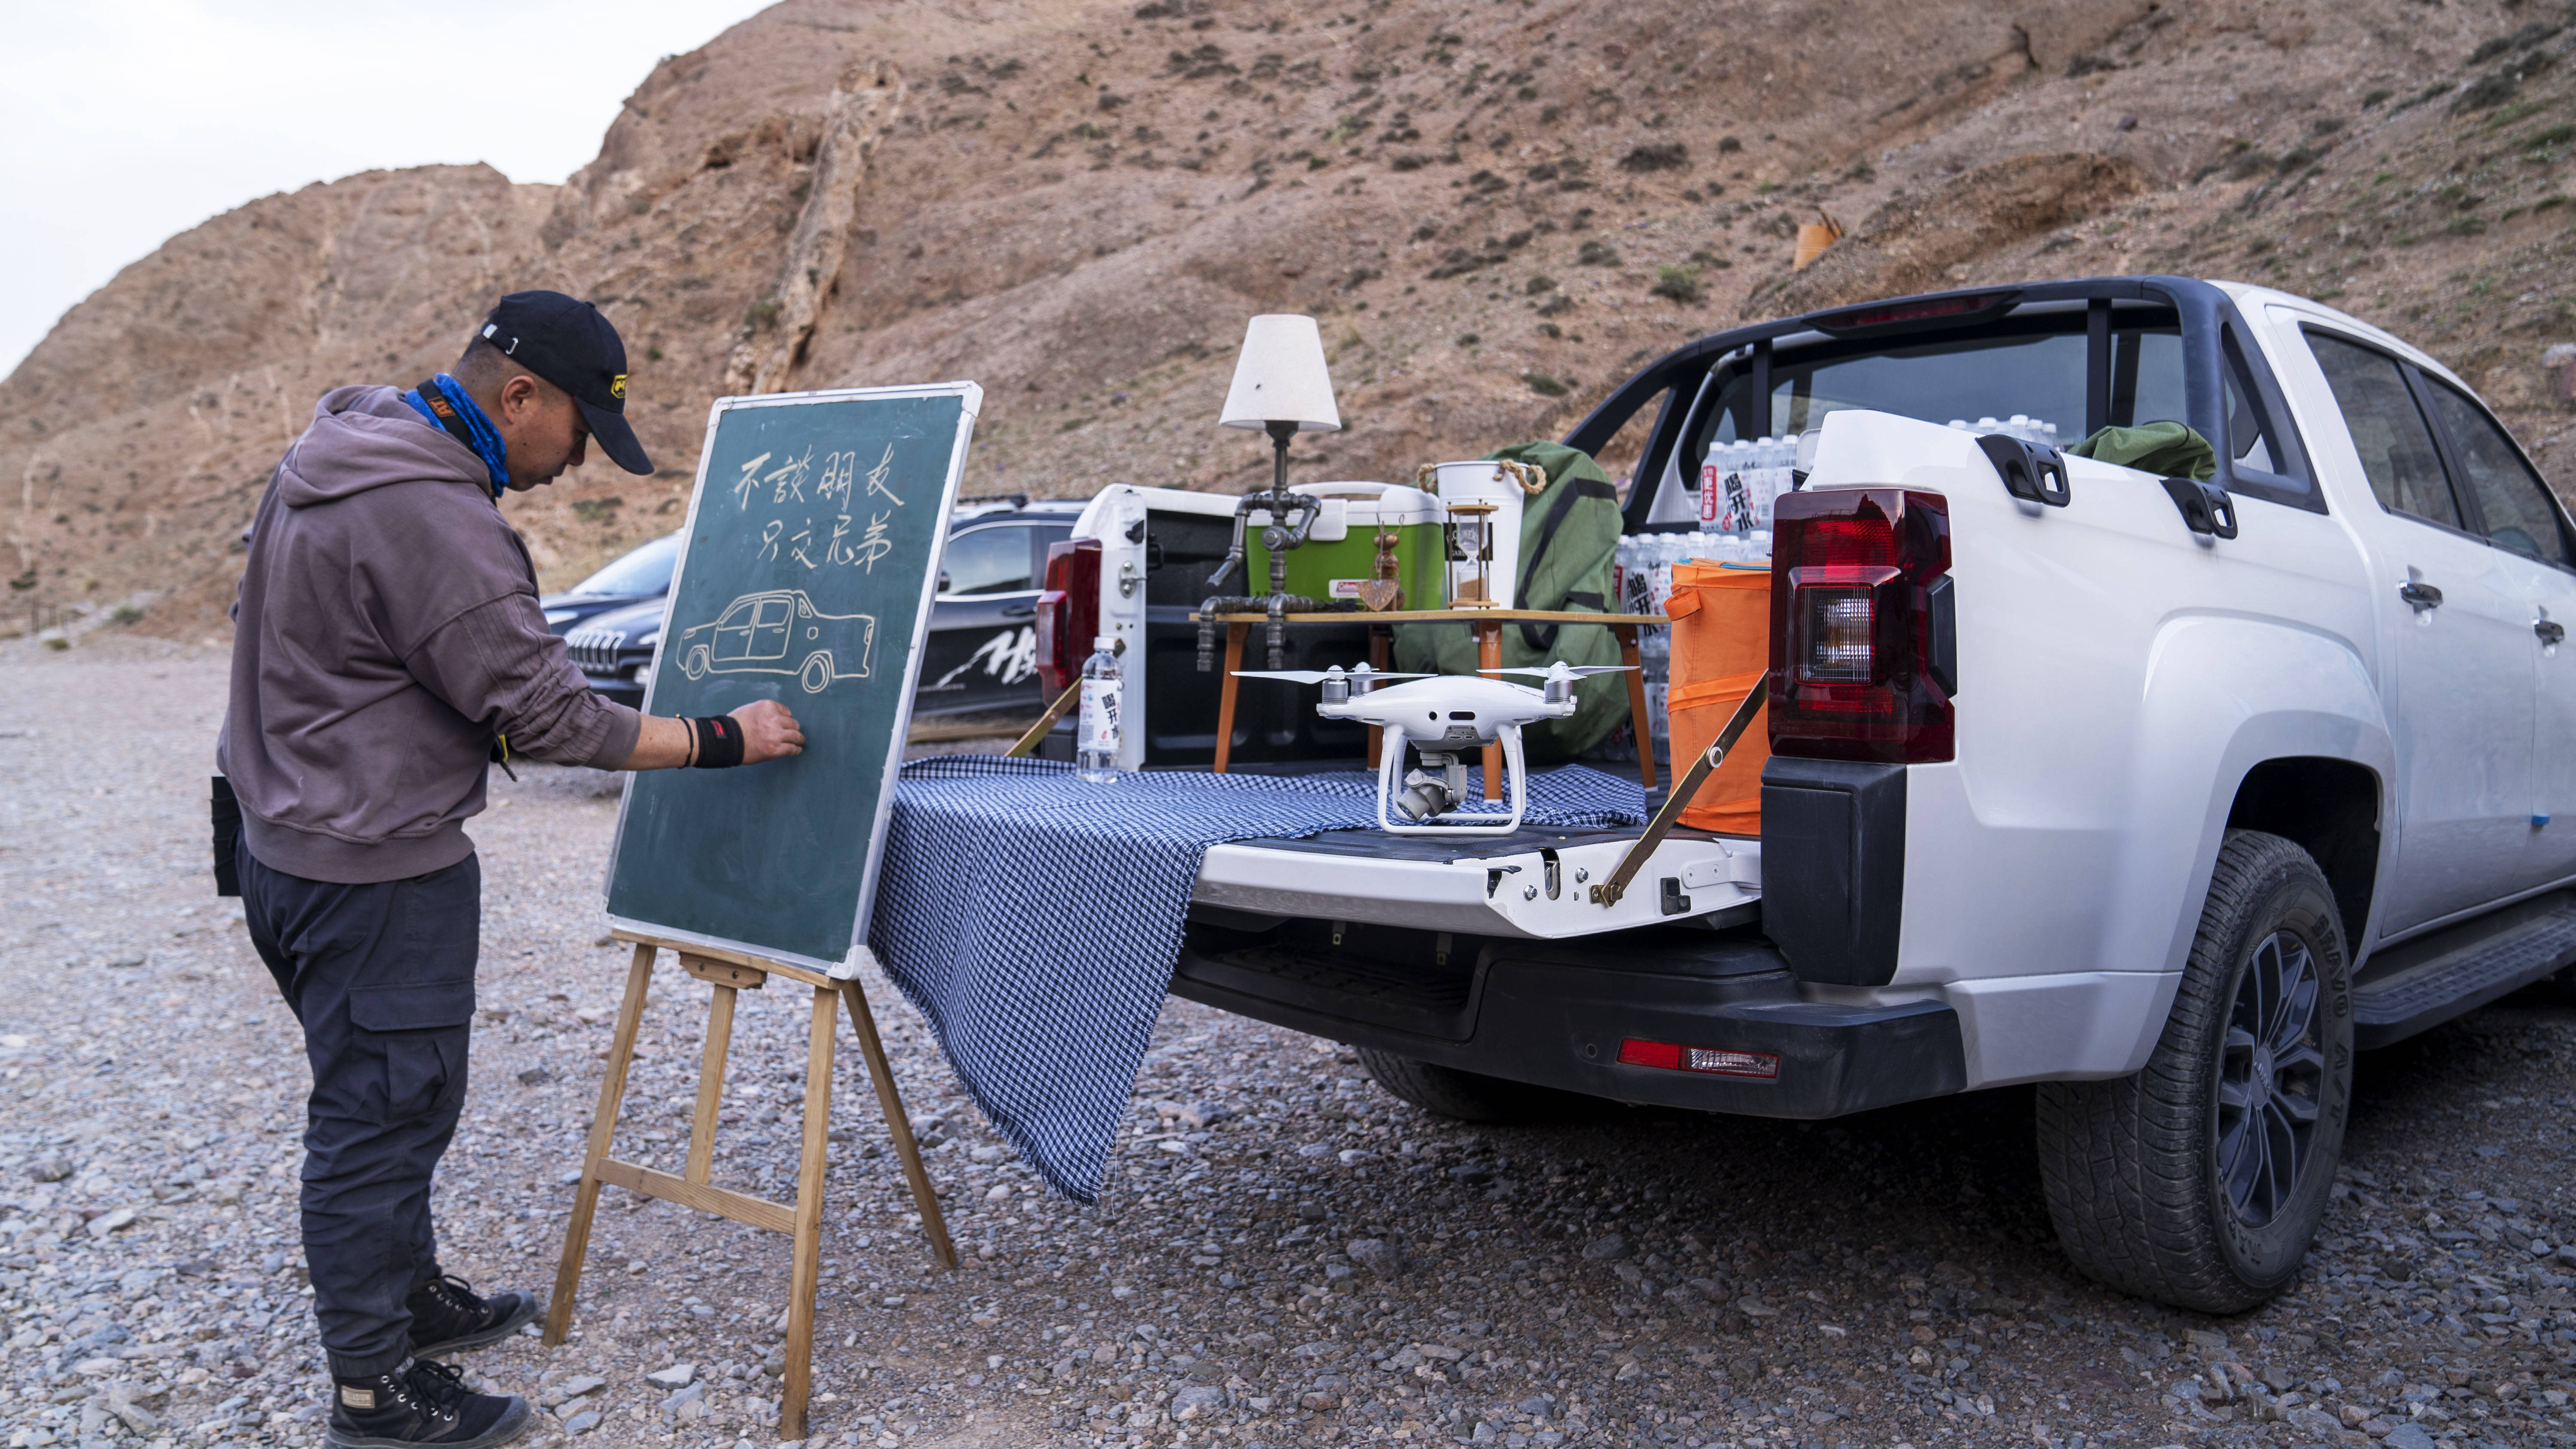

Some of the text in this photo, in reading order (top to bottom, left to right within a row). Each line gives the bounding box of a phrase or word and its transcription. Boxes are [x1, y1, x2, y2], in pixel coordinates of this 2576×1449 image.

[1724, 473, 1754, 532] 喝开水
[756, 509, 892, 575] 只交兄弟
[2312, 912, 2349, 1128] BRAVO A/T
